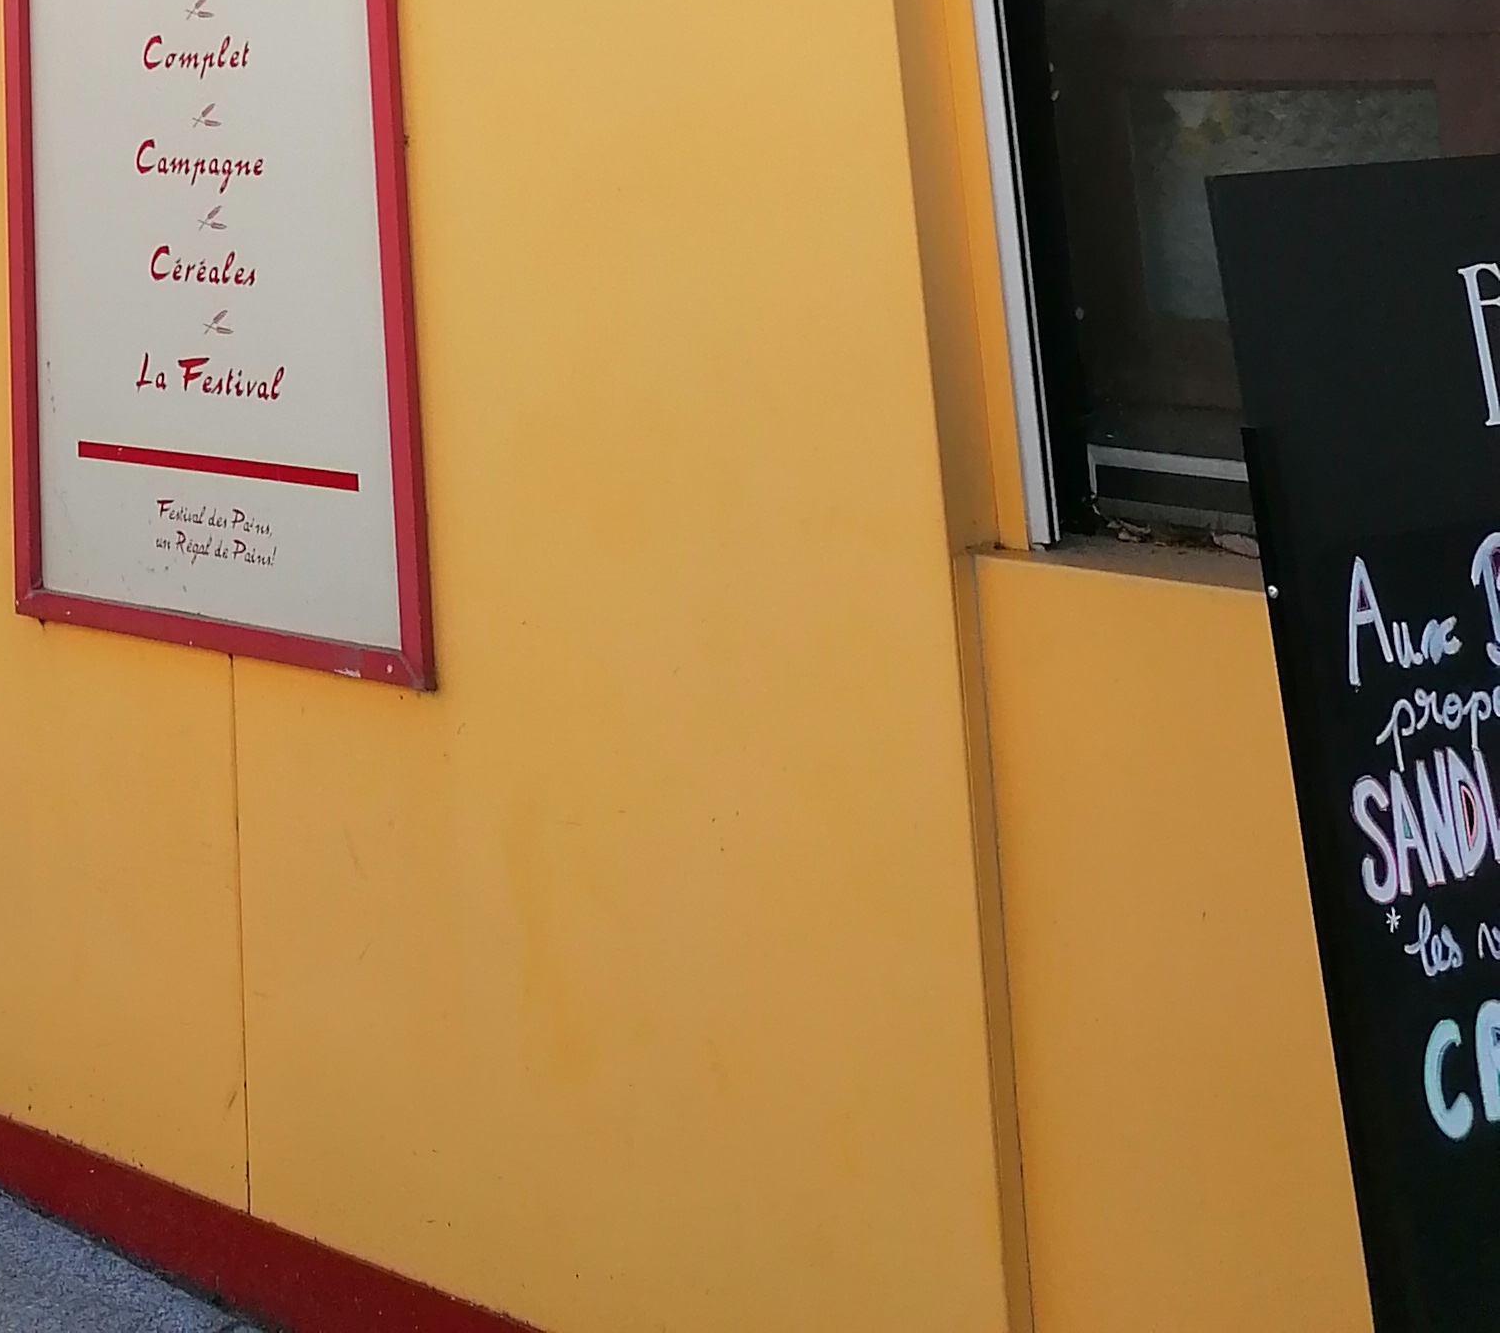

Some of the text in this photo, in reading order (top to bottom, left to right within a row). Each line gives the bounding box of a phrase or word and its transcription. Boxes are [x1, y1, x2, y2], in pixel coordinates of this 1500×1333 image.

[143, 35, 251, 78] Complet
[135, 139, 264, 194] Campagne
[149, 245, 256, 287] Céréales
[136, 352, 285, 402] La Festival
[156, 499, 206, 524] Festival
[208, 508, 227, 529] des
[156, 537, 171, 550] un
[176, 530, 213, 566] Régal
[214, 539, 229, 559] de
